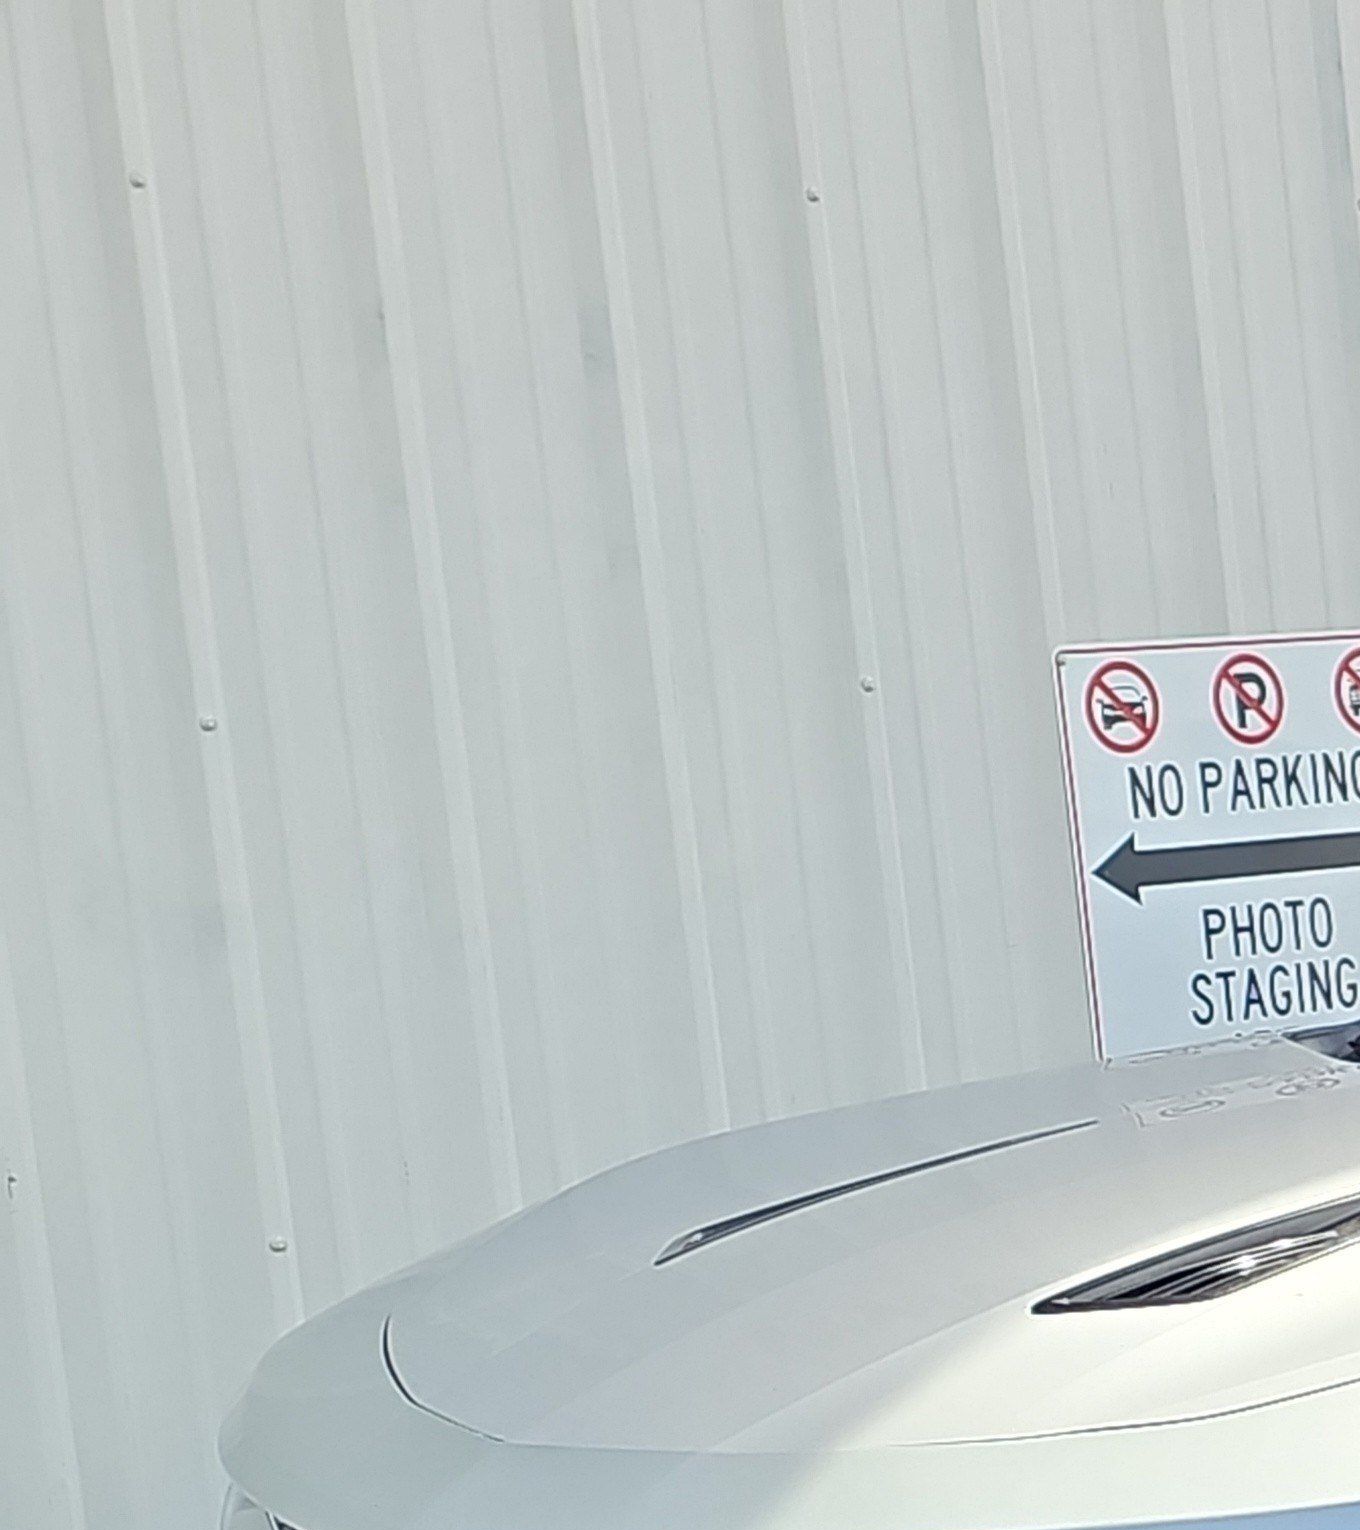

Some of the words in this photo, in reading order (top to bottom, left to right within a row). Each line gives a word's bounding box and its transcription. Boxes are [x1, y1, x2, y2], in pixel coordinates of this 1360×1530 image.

[1128, 763, 1185, 819] NO
[1202, 898, 1334, 960] PHOTO
[1190, 957, 1359, 1026] STAGING
